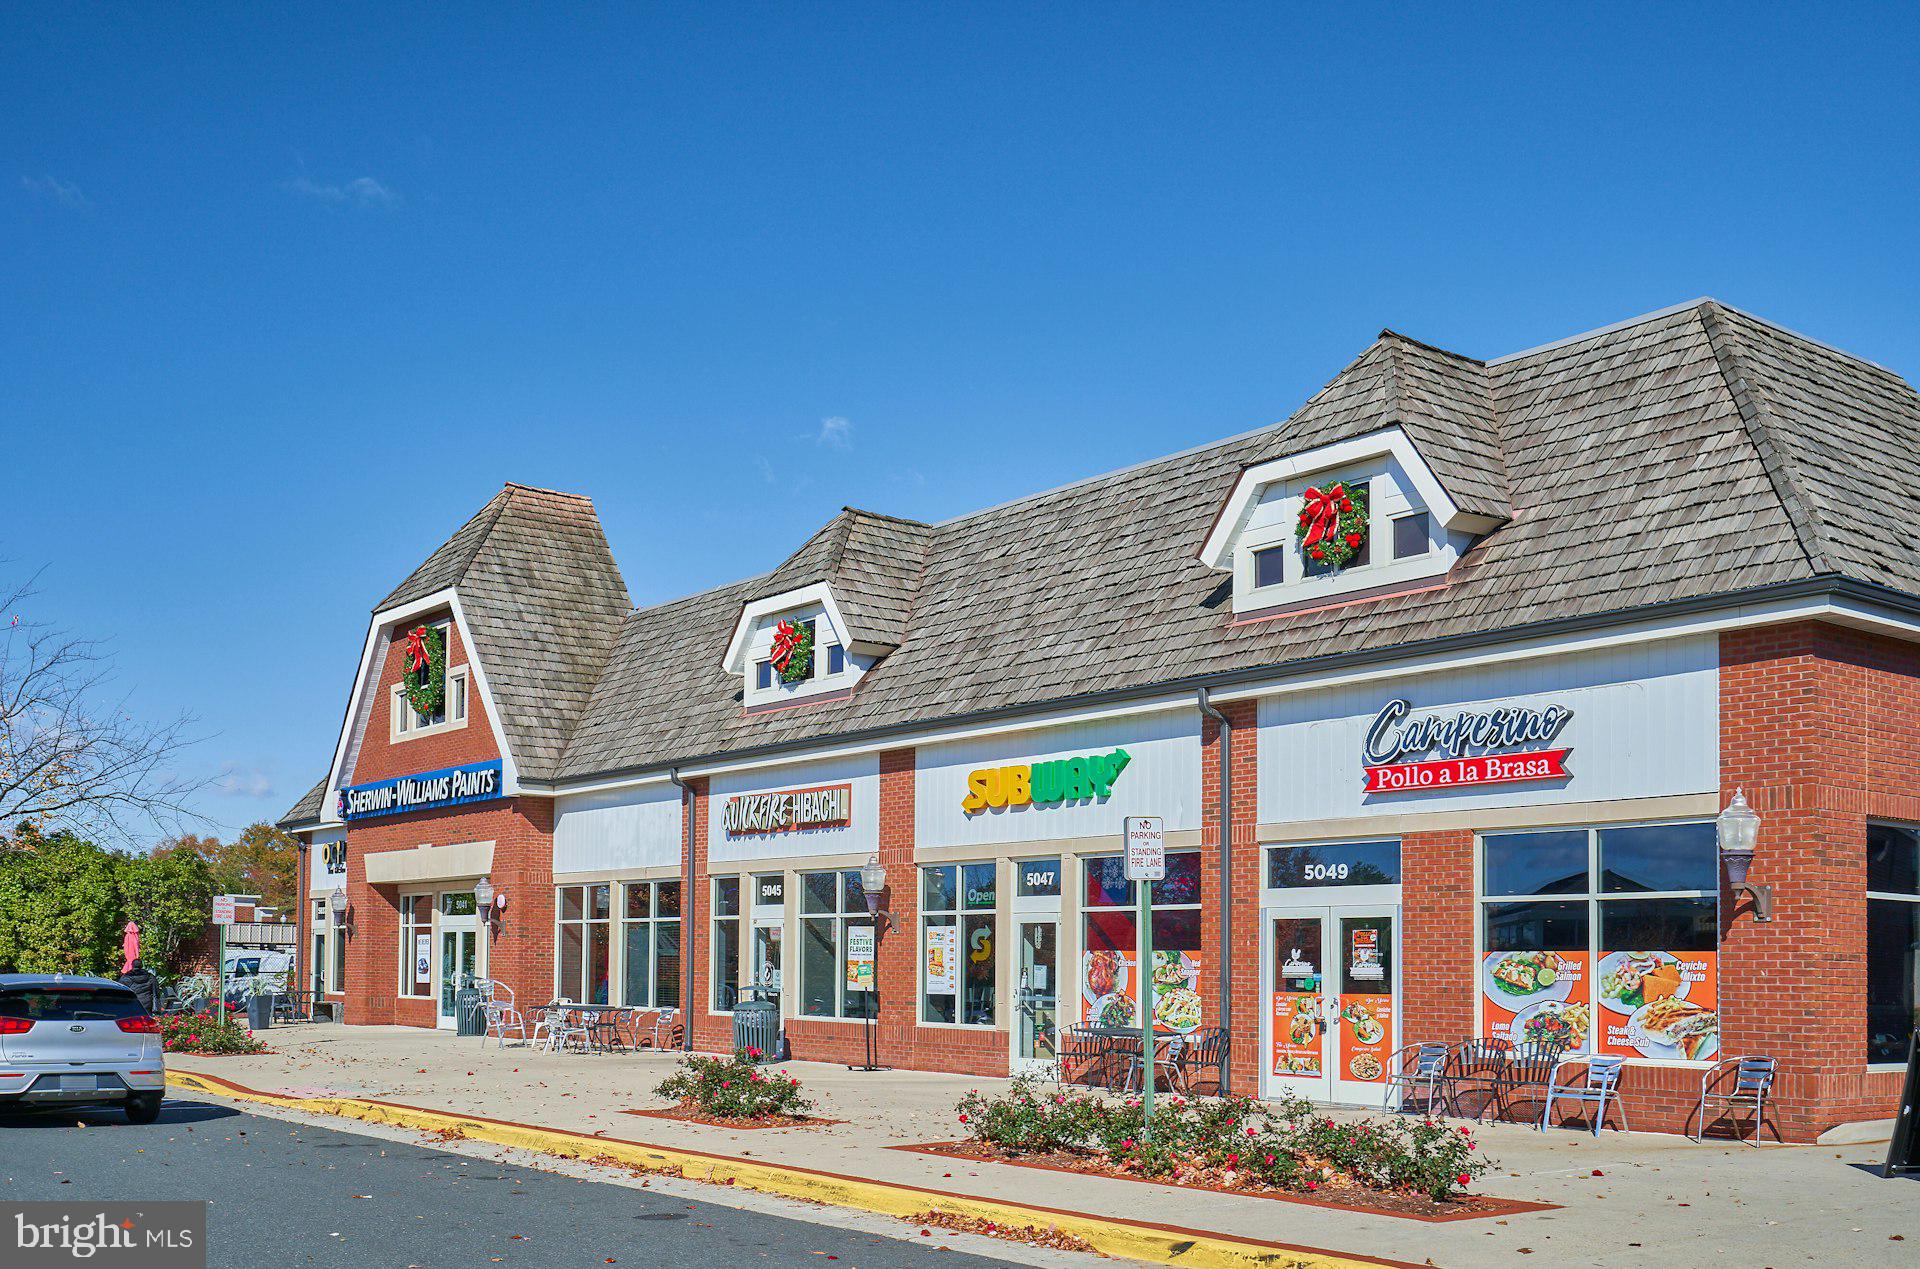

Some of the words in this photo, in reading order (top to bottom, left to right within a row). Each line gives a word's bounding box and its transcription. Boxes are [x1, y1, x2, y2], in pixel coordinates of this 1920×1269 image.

[1364, 699, 1568, 765] Campesino
[1376, 769, 1433, 789] Pollo
[1439, 770, 1452, 783] a
[1458, 765, 1478, 781] la
[1485, 758, 1551, 779] Brasa
[961, 748, 1131, 814] SUBWAY
[721, 793, 791, 831] QUICKFIRE
[792, 788, 841, 823] HIBACHI
[1139, 821, 1152, 830] NO
[1130, 831, 1161, 840] PARKING
[1130, 847, 1162, 856] STANDING
[1131, 857, 1144, 868] FIRE
[1146, 857, 1162, 868] LANE
[1303, 863, 1349, 880] 5049
[1026, 872, 1055, 886] 5047
[761, 884, 782, 897] 5045
[967, 888, 996, 904] Open
[849, 938, 873, 946] FESTIVE
[1557, 961, 1582, 971] Grilled
[1675, 960, 1708, 971] Ceviche
[1555, 972, 1582, 981] Salmon
[1682, 971, 1706, 982] Mixto
[1491, 1021, 1510, 1031] Lomo
[1607, 1025, 1629, 1035] Steak
[1629, 1026, 1636, 1036] &
[1607, 1036, 1634, 1046] Cheese
[1635, 1037, 1650, 1047] Sub
